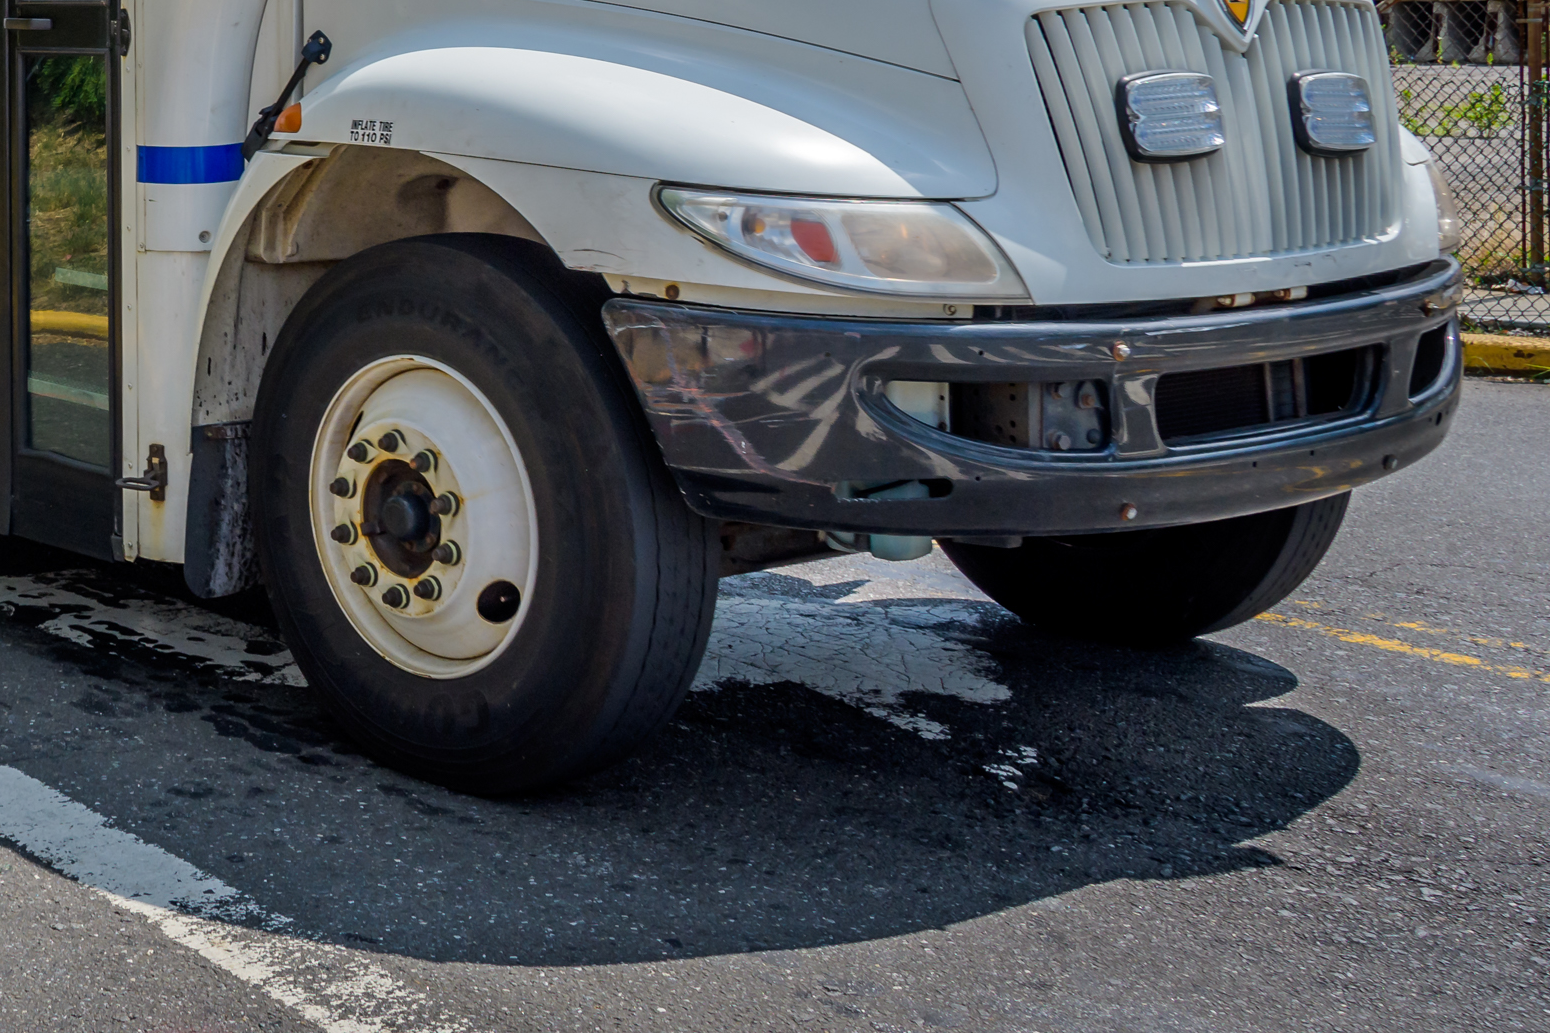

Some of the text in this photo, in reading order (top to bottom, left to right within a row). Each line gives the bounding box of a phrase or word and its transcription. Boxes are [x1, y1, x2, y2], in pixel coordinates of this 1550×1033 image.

[351, 120, 394, 132] INFLATE TIRE
[350, 131, 393, 144] TO 110 PSI
